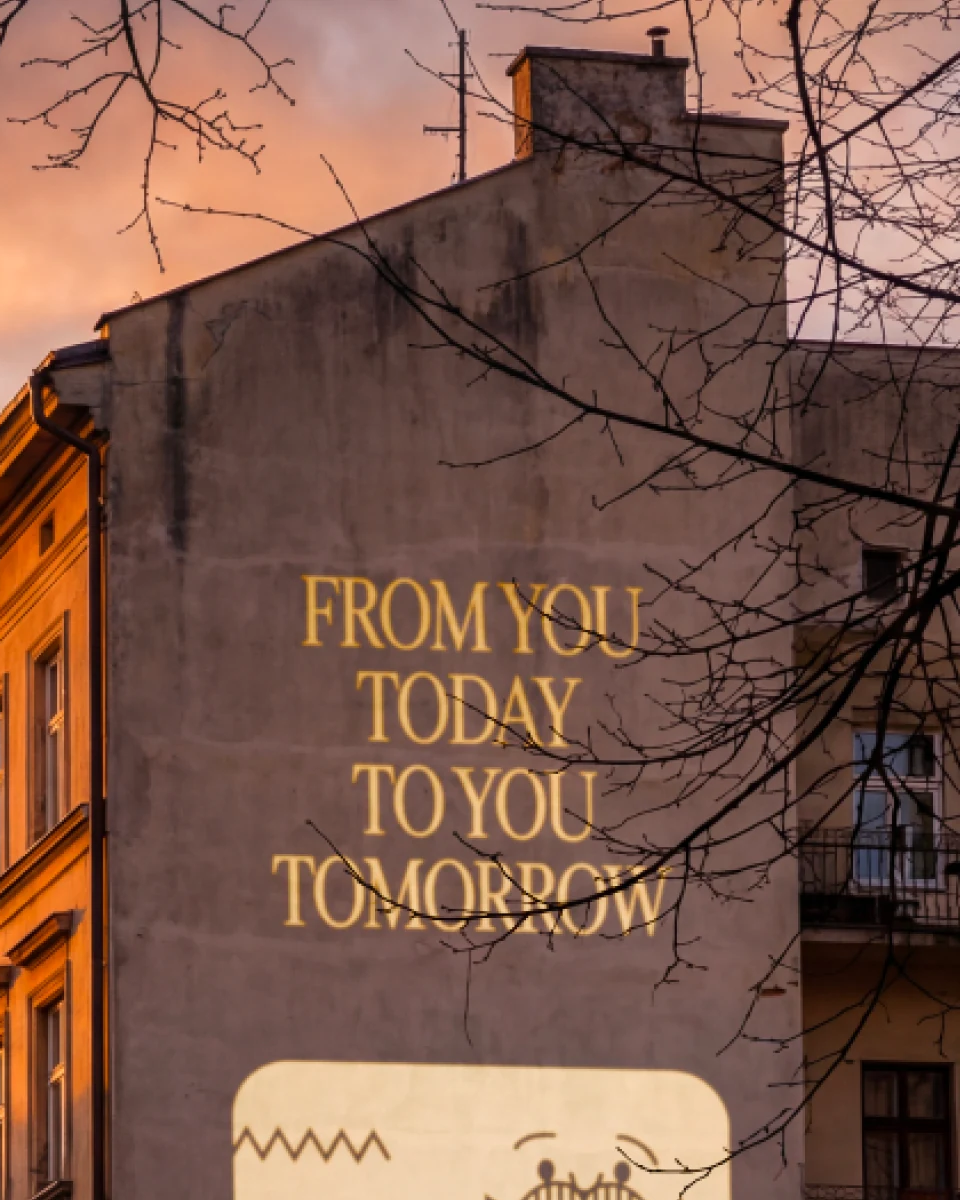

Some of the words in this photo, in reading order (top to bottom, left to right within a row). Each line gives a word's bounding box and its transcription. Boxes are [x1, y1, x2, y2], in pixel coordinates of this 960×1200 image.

[301, 574, 493, 653] FROM
[497, 582, 644, 658] YOU
[355, 670, 584, 749] TODAY
[351, 763, 446, 838] TO
[450, 766, 598, 843] YOU
[271, 854, 673, 936] TOMORROW
